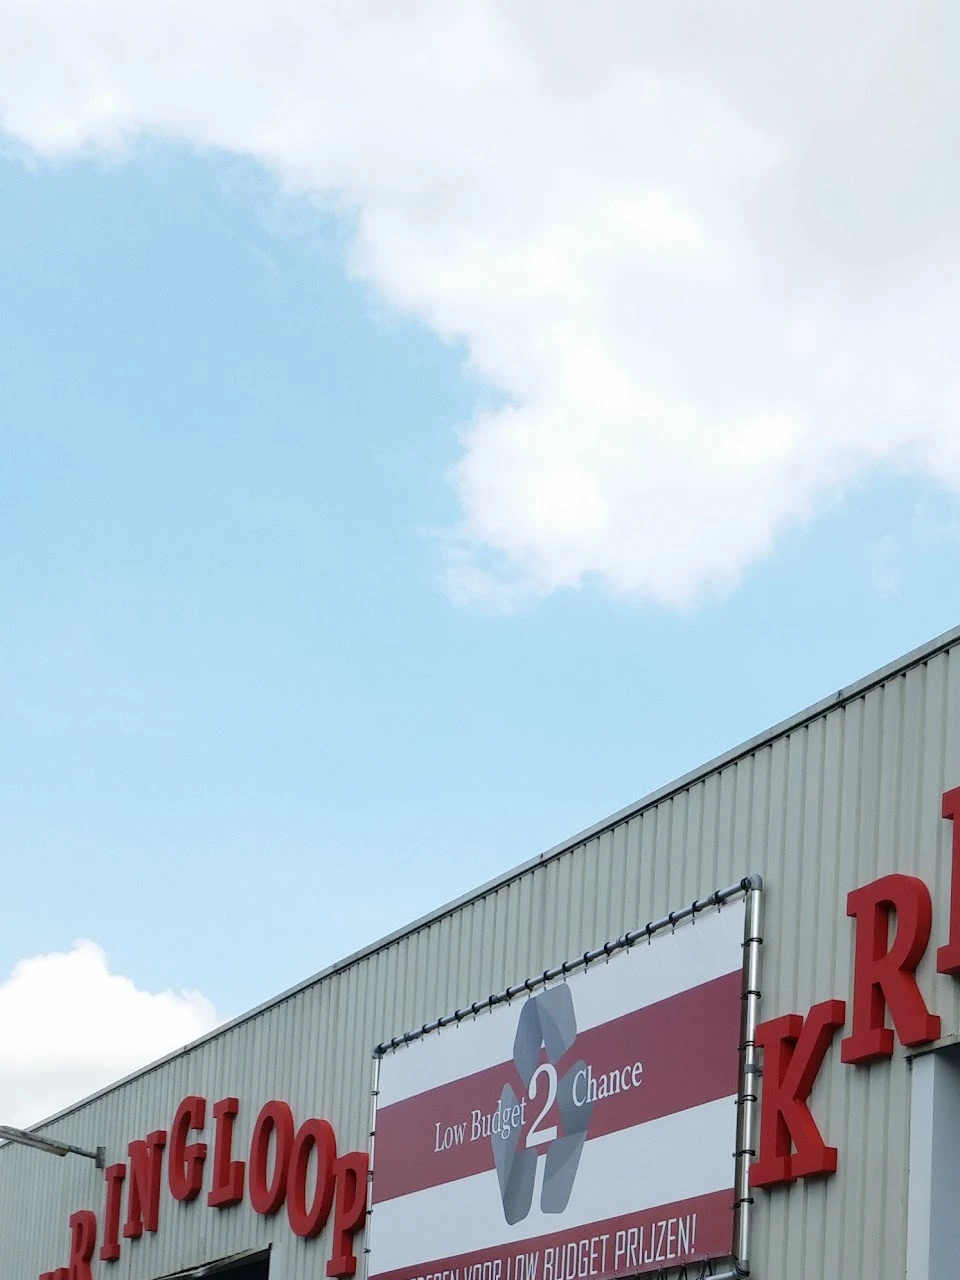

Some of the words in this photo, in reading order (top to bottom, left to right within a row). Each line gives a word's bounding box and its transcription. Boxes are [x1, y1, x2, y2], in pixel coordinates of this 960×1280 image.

[433, 1122, 467, 1152] Low
[470, 1097, 527, 1139] Budget
[525, 1063, 558, 1149] 2
[572, 1061, 643, 1107] Chance
[615, 1213, 697, 1271] PRIJZEN!
